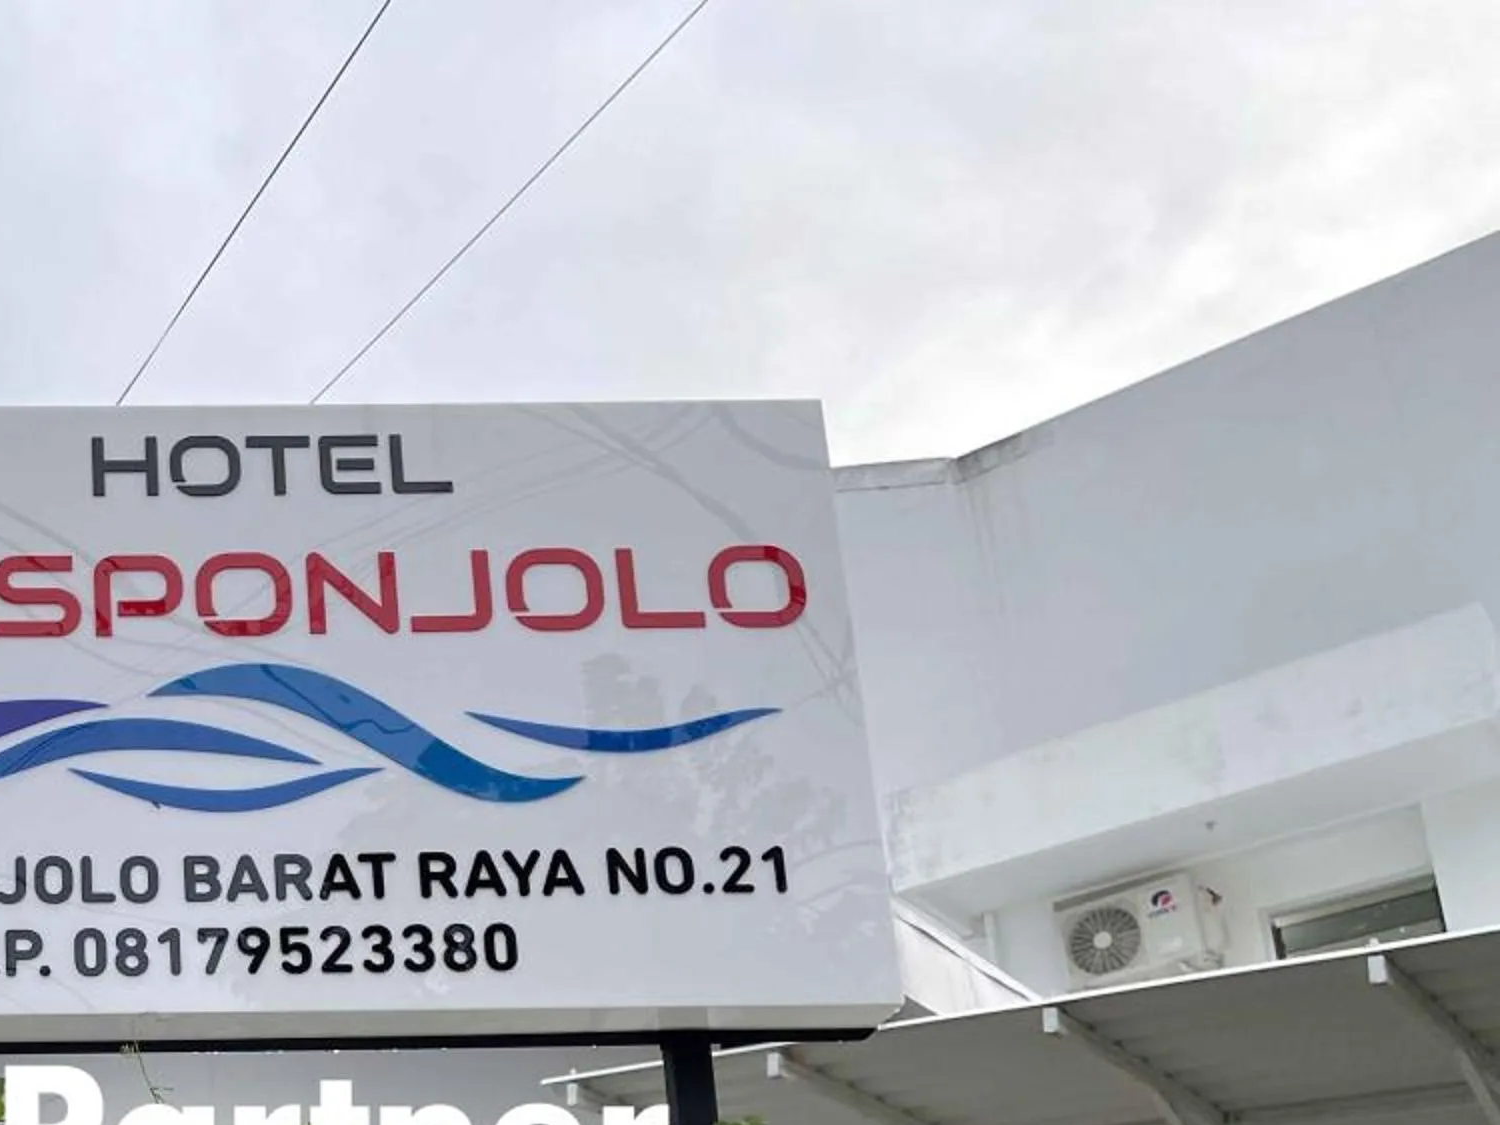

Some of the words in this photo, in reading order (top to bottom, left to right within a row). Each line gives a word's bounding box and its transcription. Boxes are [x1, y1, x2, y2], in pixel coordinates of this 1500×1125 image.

[90, 432, 455, 500] HOTEL
[182, 850, 398, 904] BARAT
[416, 847, 587, 901] RAYA
[604, 844, 789, 897] NO.21
[72, 921, 520, 978] 08179523380
